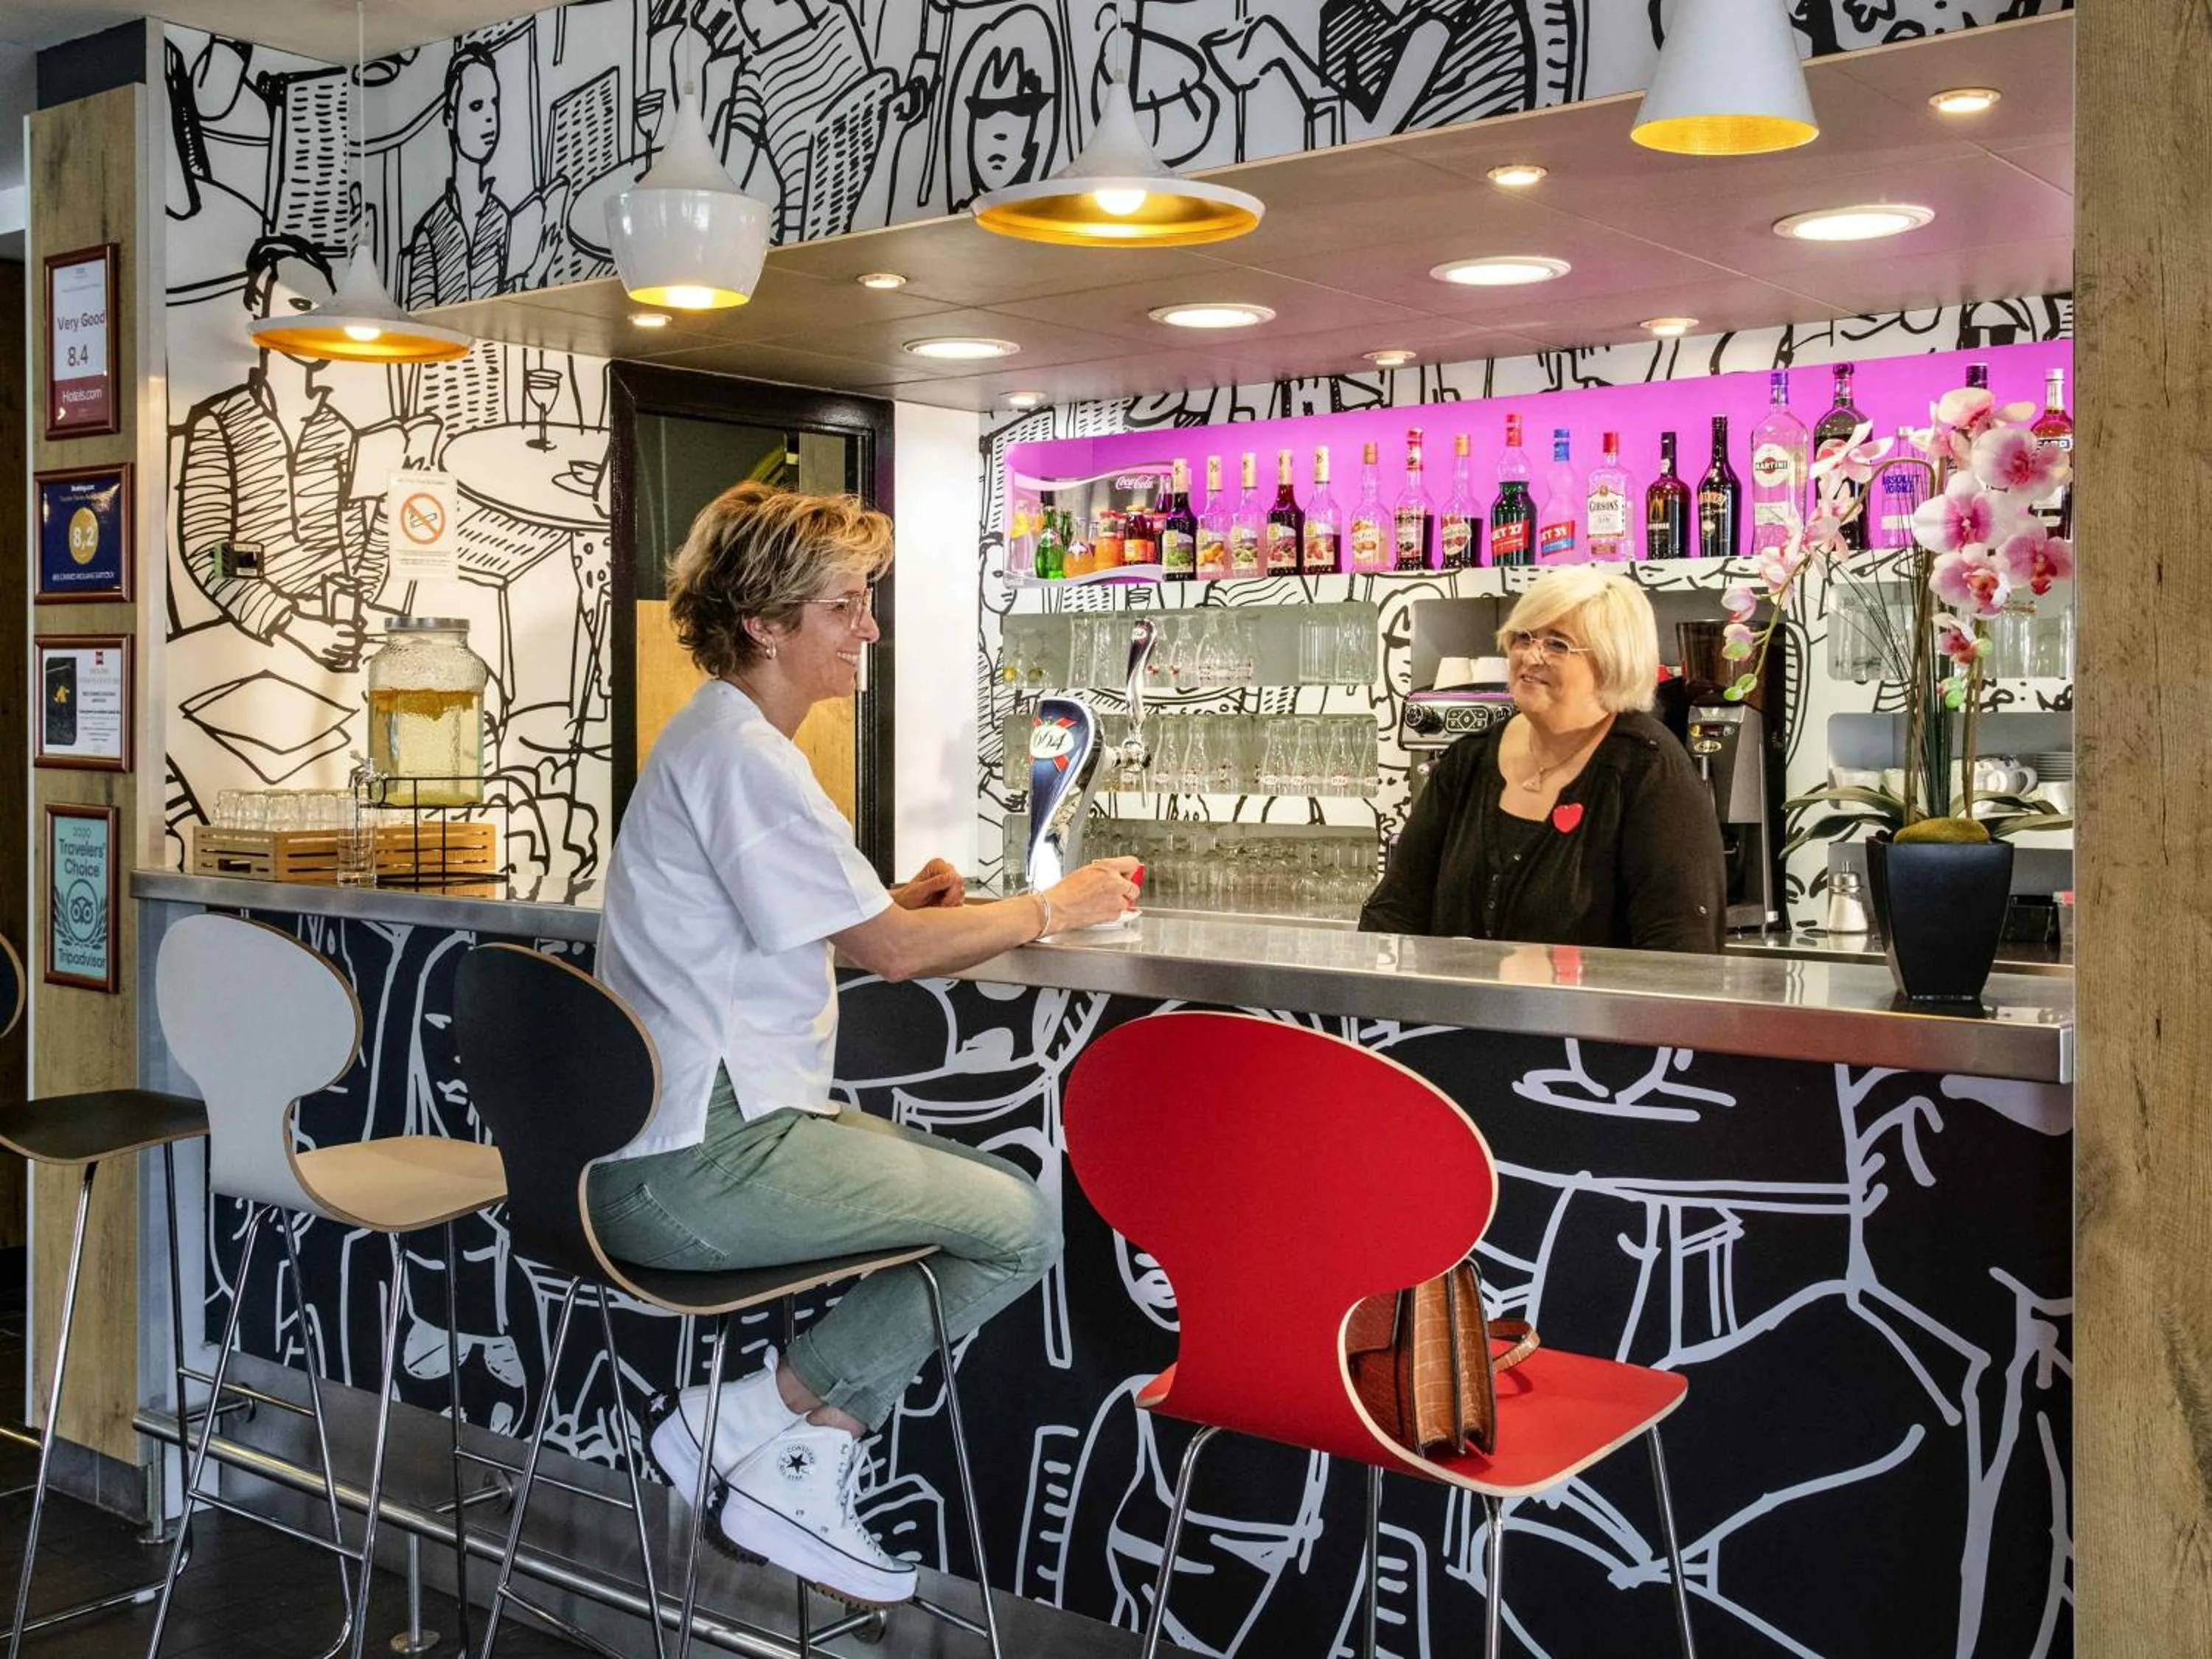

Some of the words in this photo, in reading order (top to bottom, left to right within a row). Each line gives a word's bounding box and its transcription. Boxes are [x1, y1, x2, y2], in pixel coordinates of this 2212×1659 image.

[58, 316, 78, 332] Very
[81, 312, 105, 327] Good
[68, 344, 88, 366] 8.4
[62, 389, 102, 404] Hotels.com
[1116, 475, 1154, 490] Coca-Cola
[73, 526, 95, 550] 8,2
[59, 838, 105, 858] Travelers'
[65, 858, 100, 877] Choice
[59, 947, 105, 967] Tripadvisor
